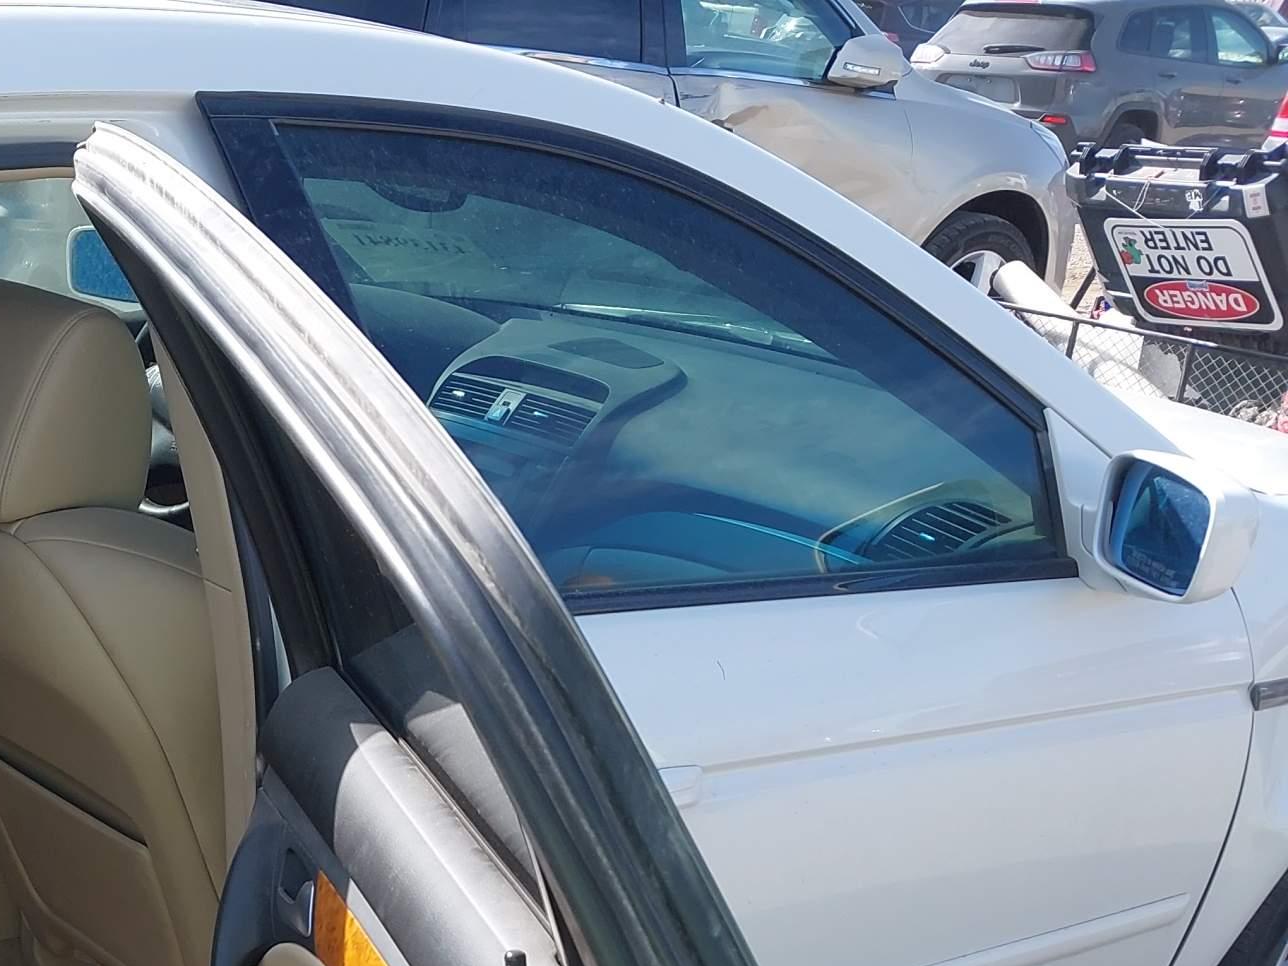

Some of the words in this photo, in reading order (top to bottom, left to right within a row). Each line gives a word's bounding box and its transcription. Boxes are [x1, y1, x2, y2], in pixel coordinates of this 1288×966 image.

[968, 57, 990, 69] Jeep
[1140, 229, 1214, 251] ENTER
[1145, 254, 1192, 275] NOT
[1196, 255, 1233, 277] DO
[1154, 289, 1248, 312] DANGER
